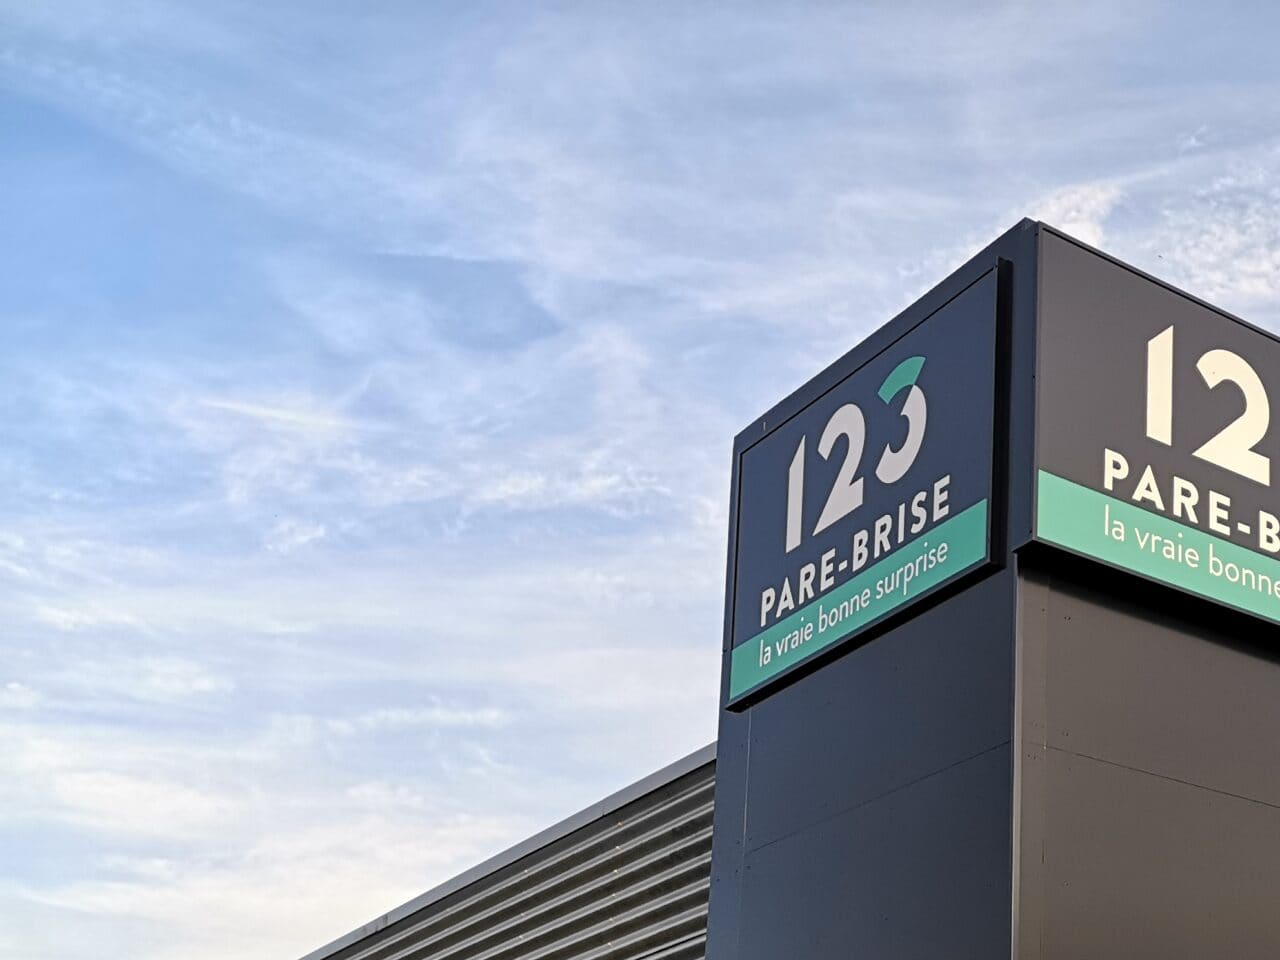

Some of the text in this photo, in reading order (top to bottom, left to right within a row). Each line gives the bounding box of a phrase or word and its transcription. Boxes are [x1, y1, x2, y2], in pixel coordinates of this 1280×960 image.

[786, 356, 928, 553] 123
[759, 542, 949, 668] la vraie bonne surprise
[760, 475, 950, 627] PARE-BRISE
[1104, 504, 1125, 542] la
[1135, 533, 1200, 568] vraie
